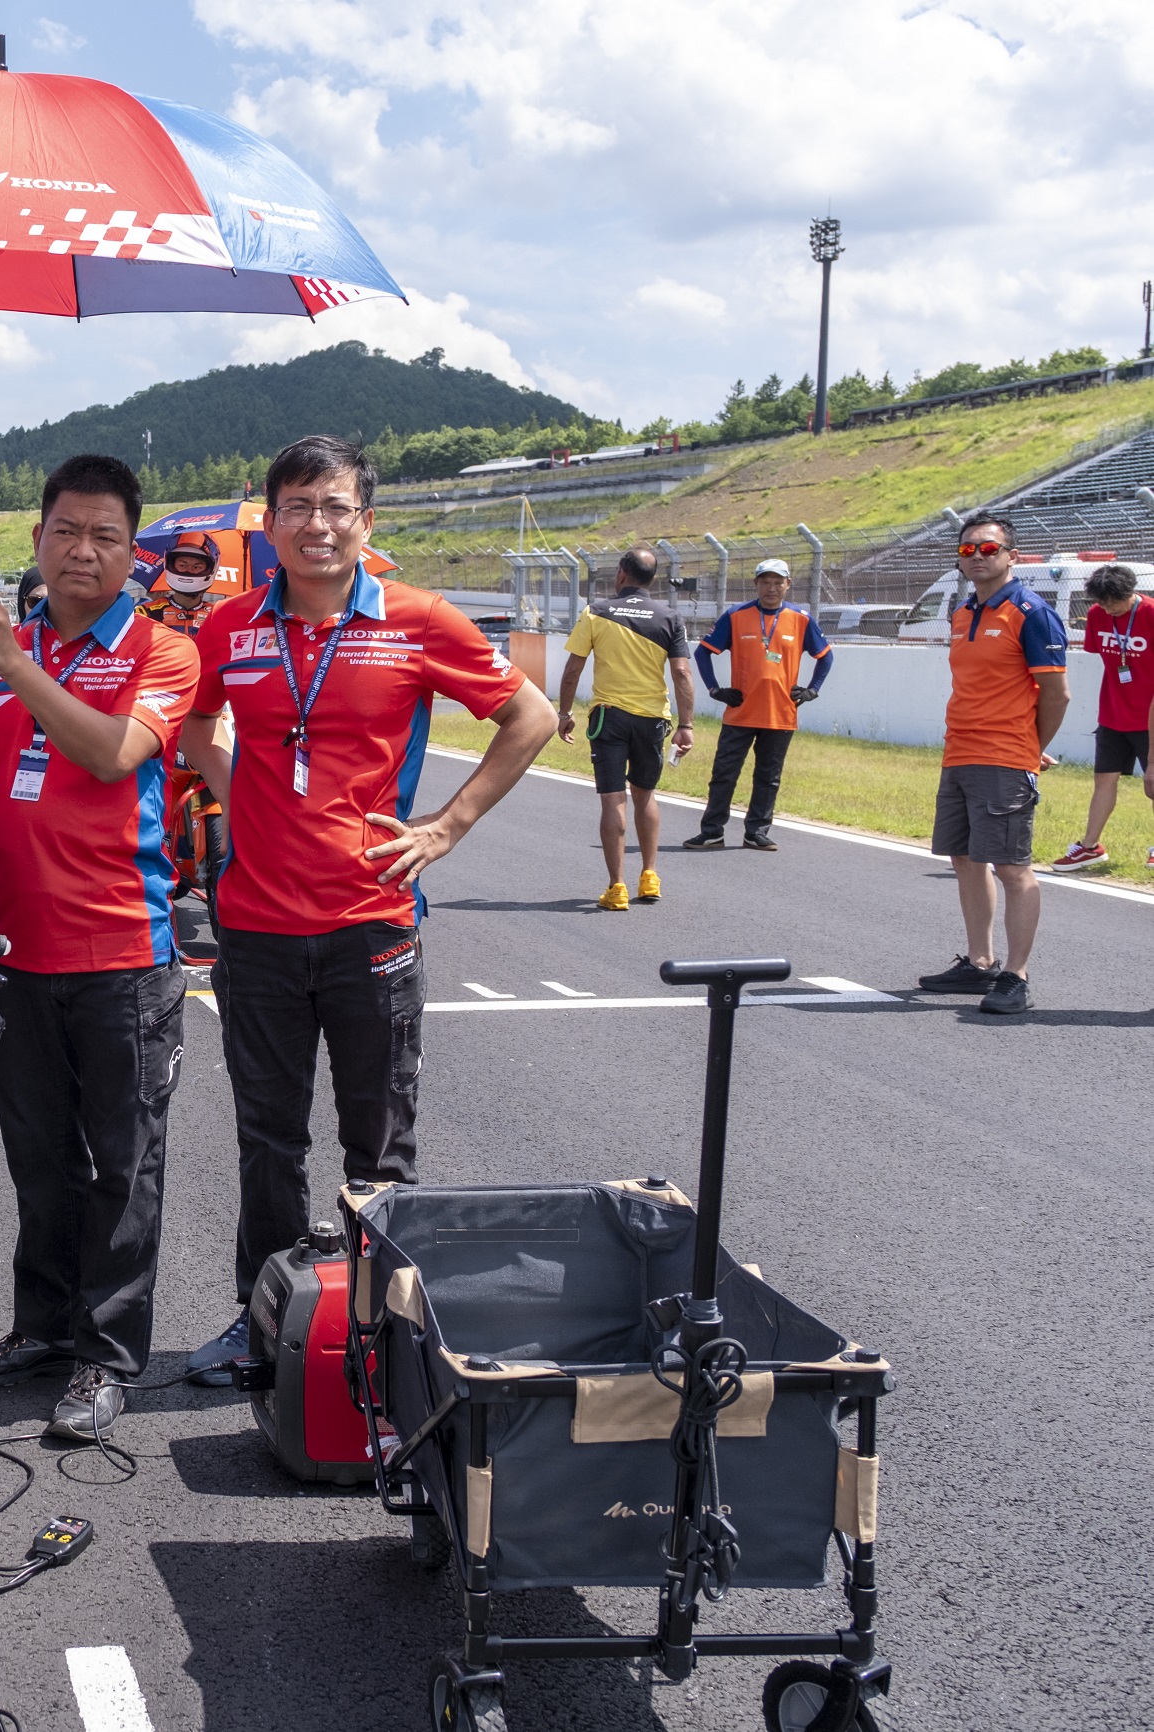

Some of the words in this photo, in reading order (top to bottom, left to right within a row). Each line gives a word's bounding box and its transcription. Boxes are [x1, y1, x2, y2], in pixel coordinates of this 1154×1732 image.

[10, 177, 116, 193] HONDA
[330, 629, 341, 645] ROAD
[340, 630, 408, 641] HONDA
[81, 657, 135, 666] HONDA
[281, 650, 291, 671] RACING
[320, 645, 334, 668] RACING
[349, 658, 395, 666] Vietnam
[373, 651, 408, 662] Racing
[59, 661, 77, 682] RACING
[287, 671, 296, 687] ROAD
[370, 941, 413, 964] HONDA
[371, 960, 395, 973] Honda
[261, 1280, 277, 1309] HONDA
